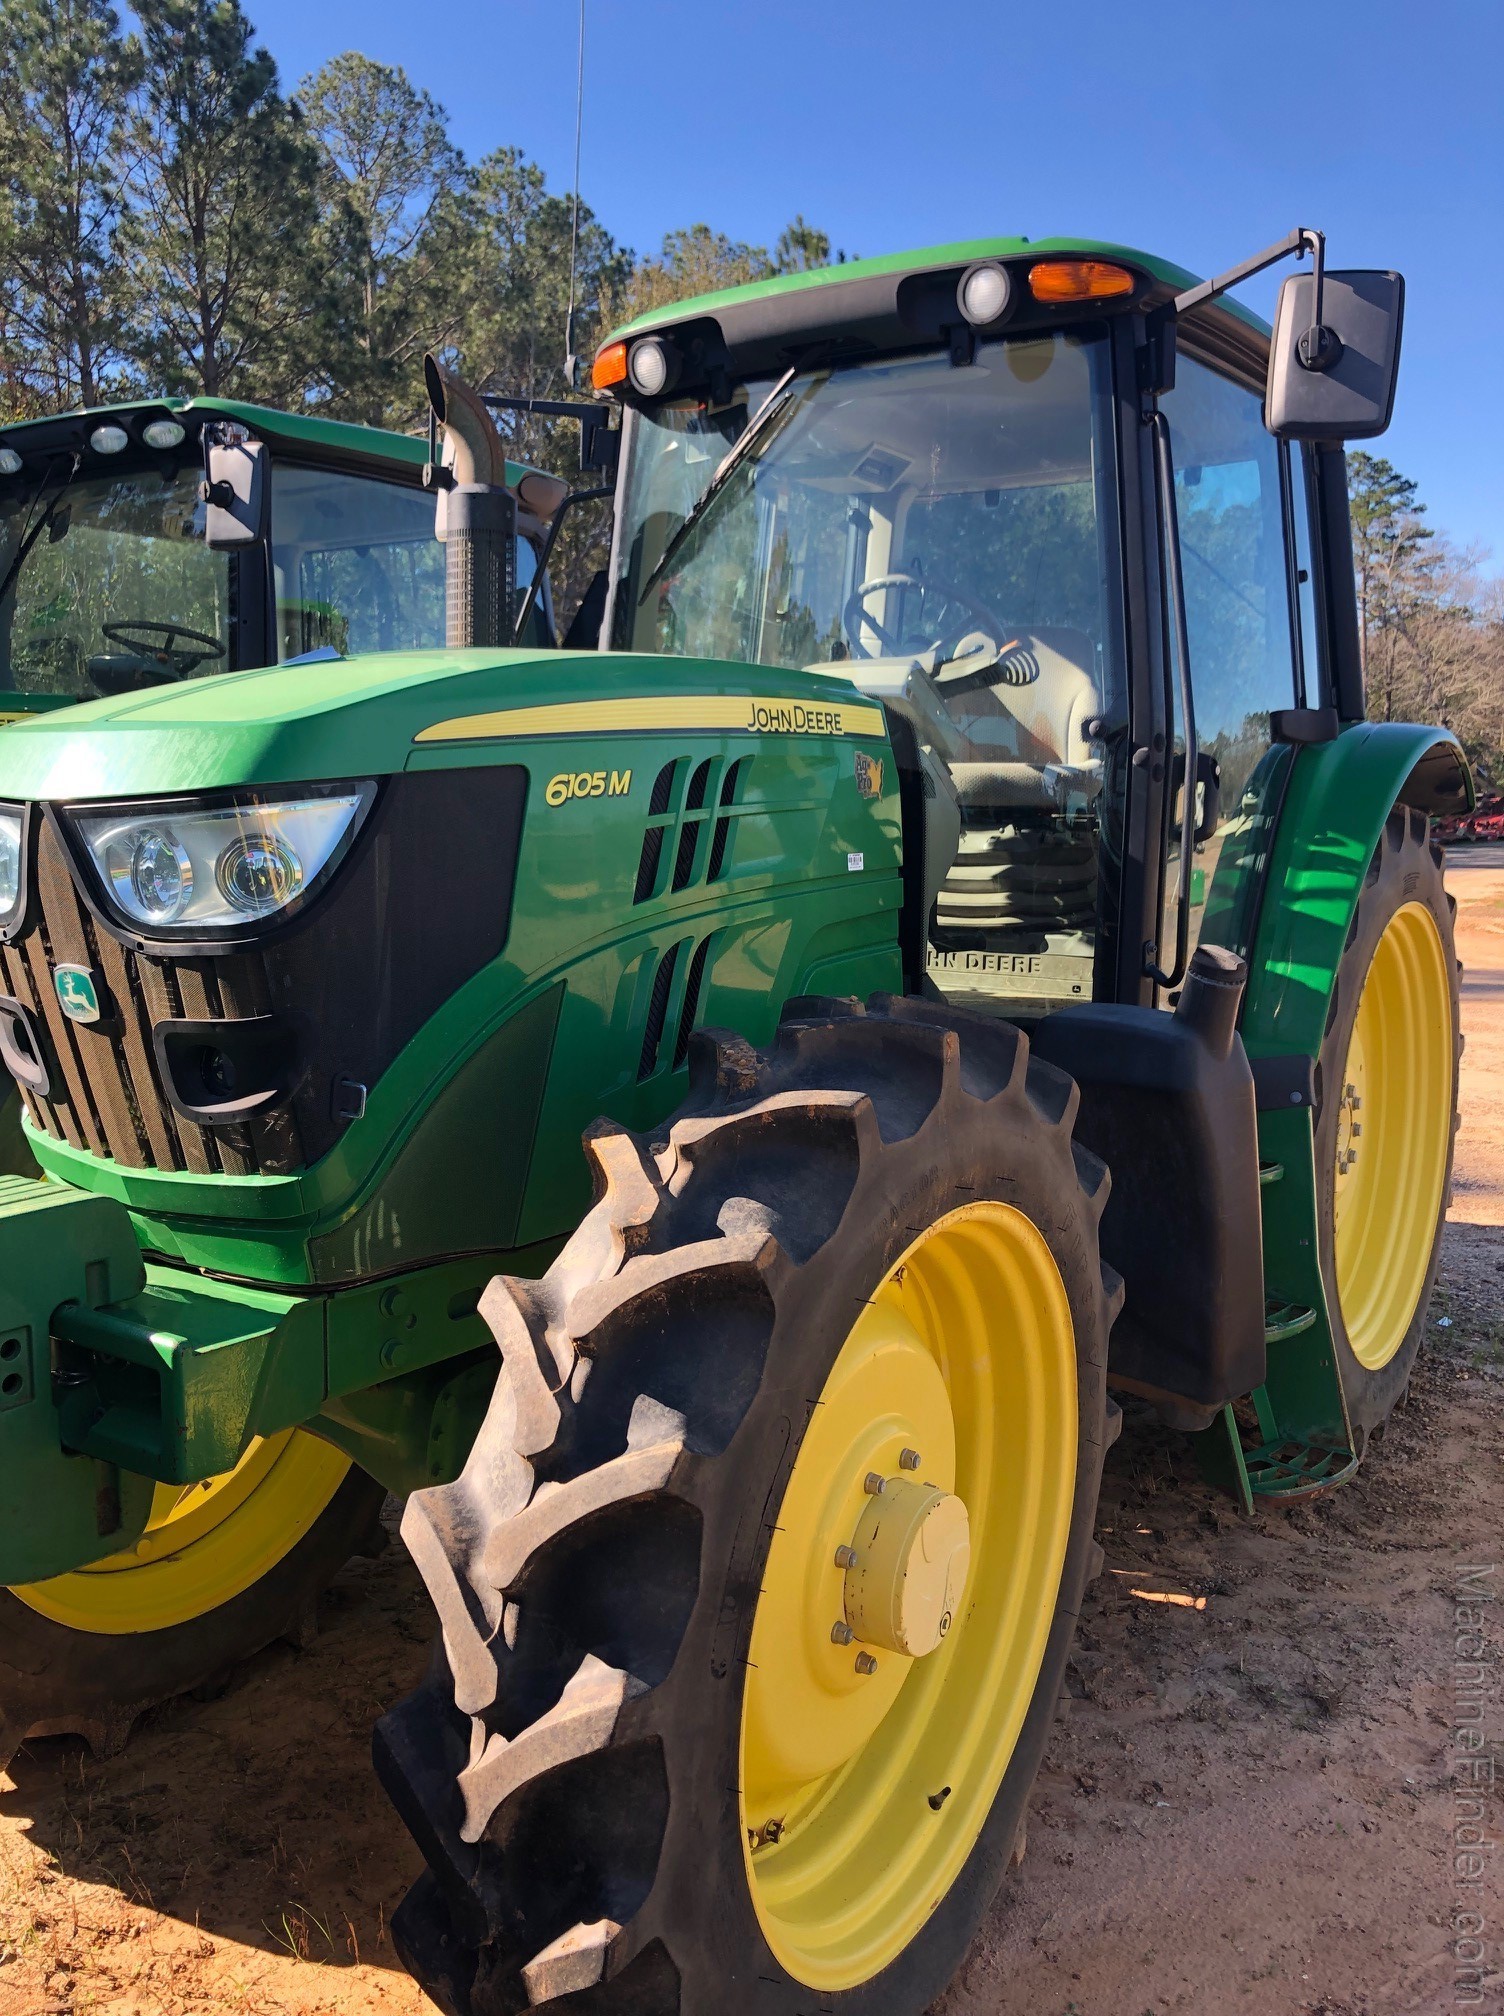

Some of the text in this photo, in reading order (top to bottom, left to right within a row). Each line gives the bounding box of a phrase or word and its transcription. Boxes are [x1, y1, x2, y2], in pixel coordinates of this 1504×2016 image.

[746, 703, 843, 731] JOHN DEERE
[966, 953, 1041, 973] DEERE
